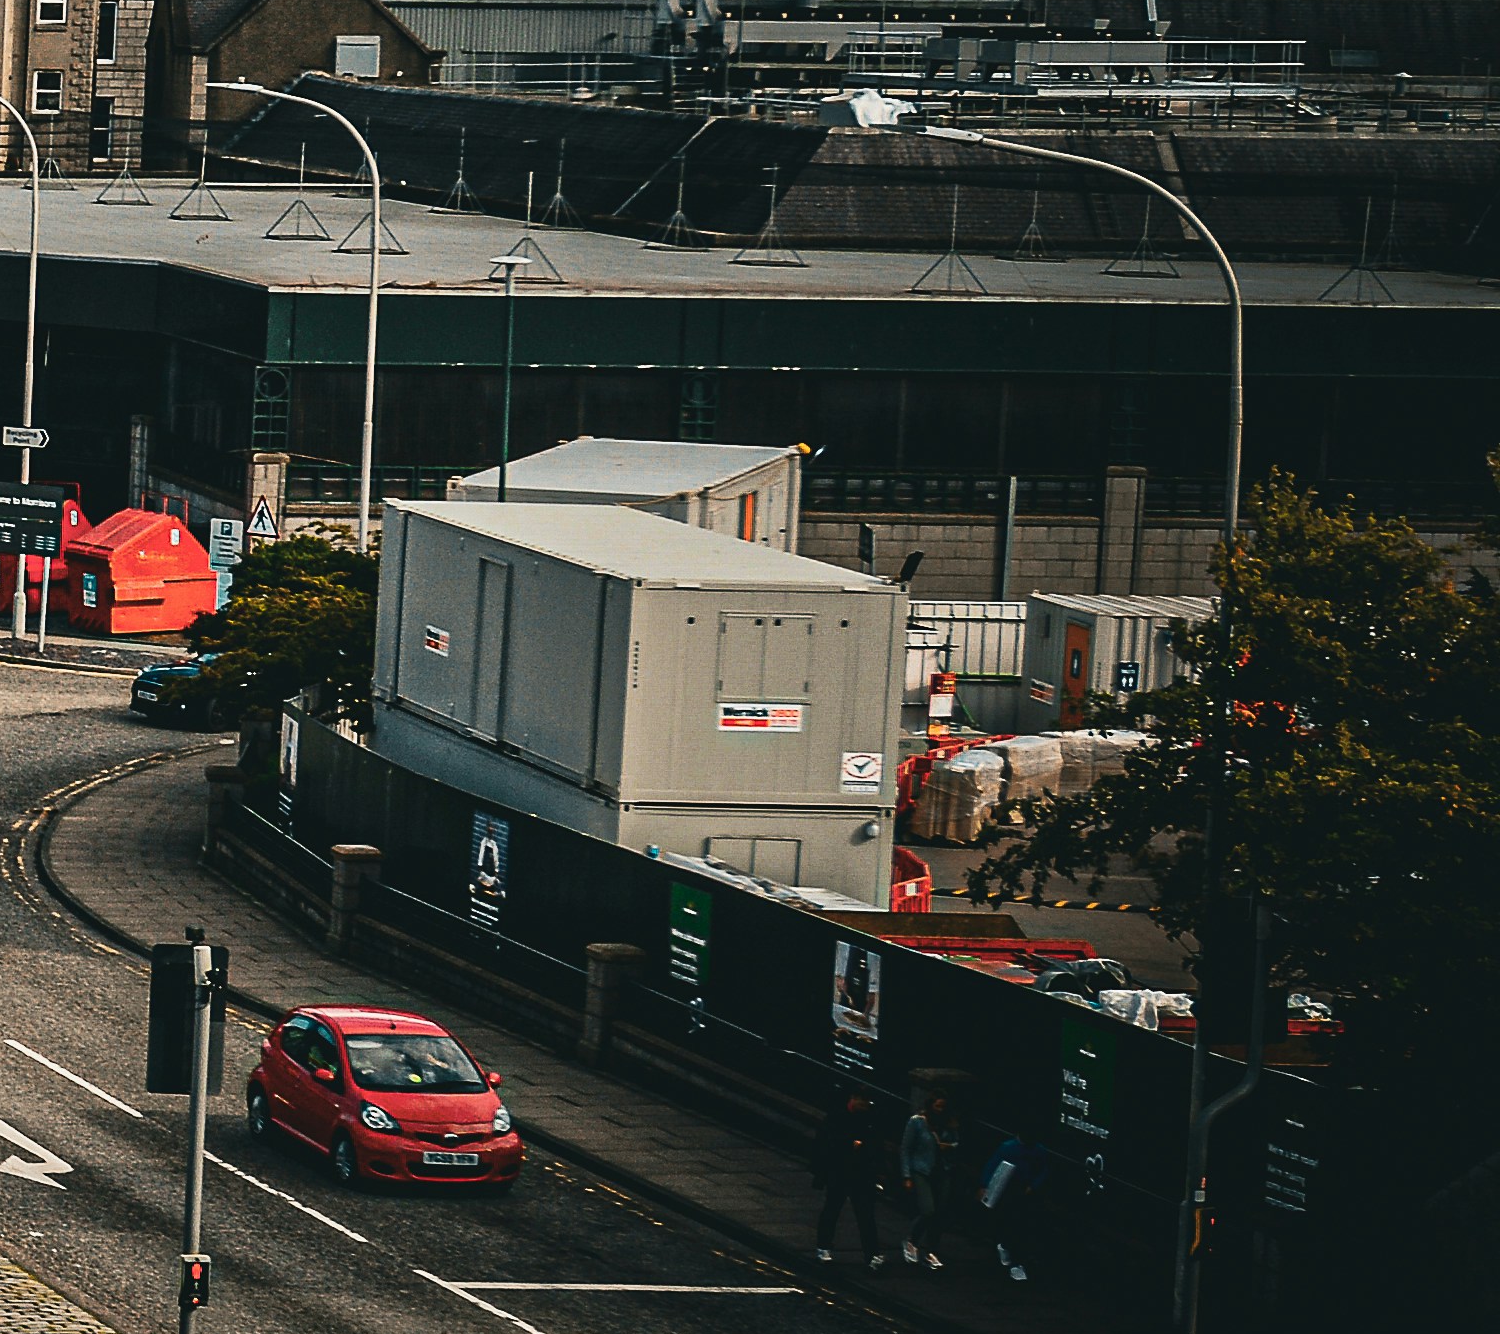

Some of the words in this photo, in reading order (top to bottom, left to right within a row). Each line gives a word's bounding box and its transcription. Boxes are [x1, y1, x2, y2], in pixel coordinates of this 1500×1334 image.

[12, 497, 20, 505] to
[21, 498, 57, 508] Morrisons
[222, 523, 231, 534] P
